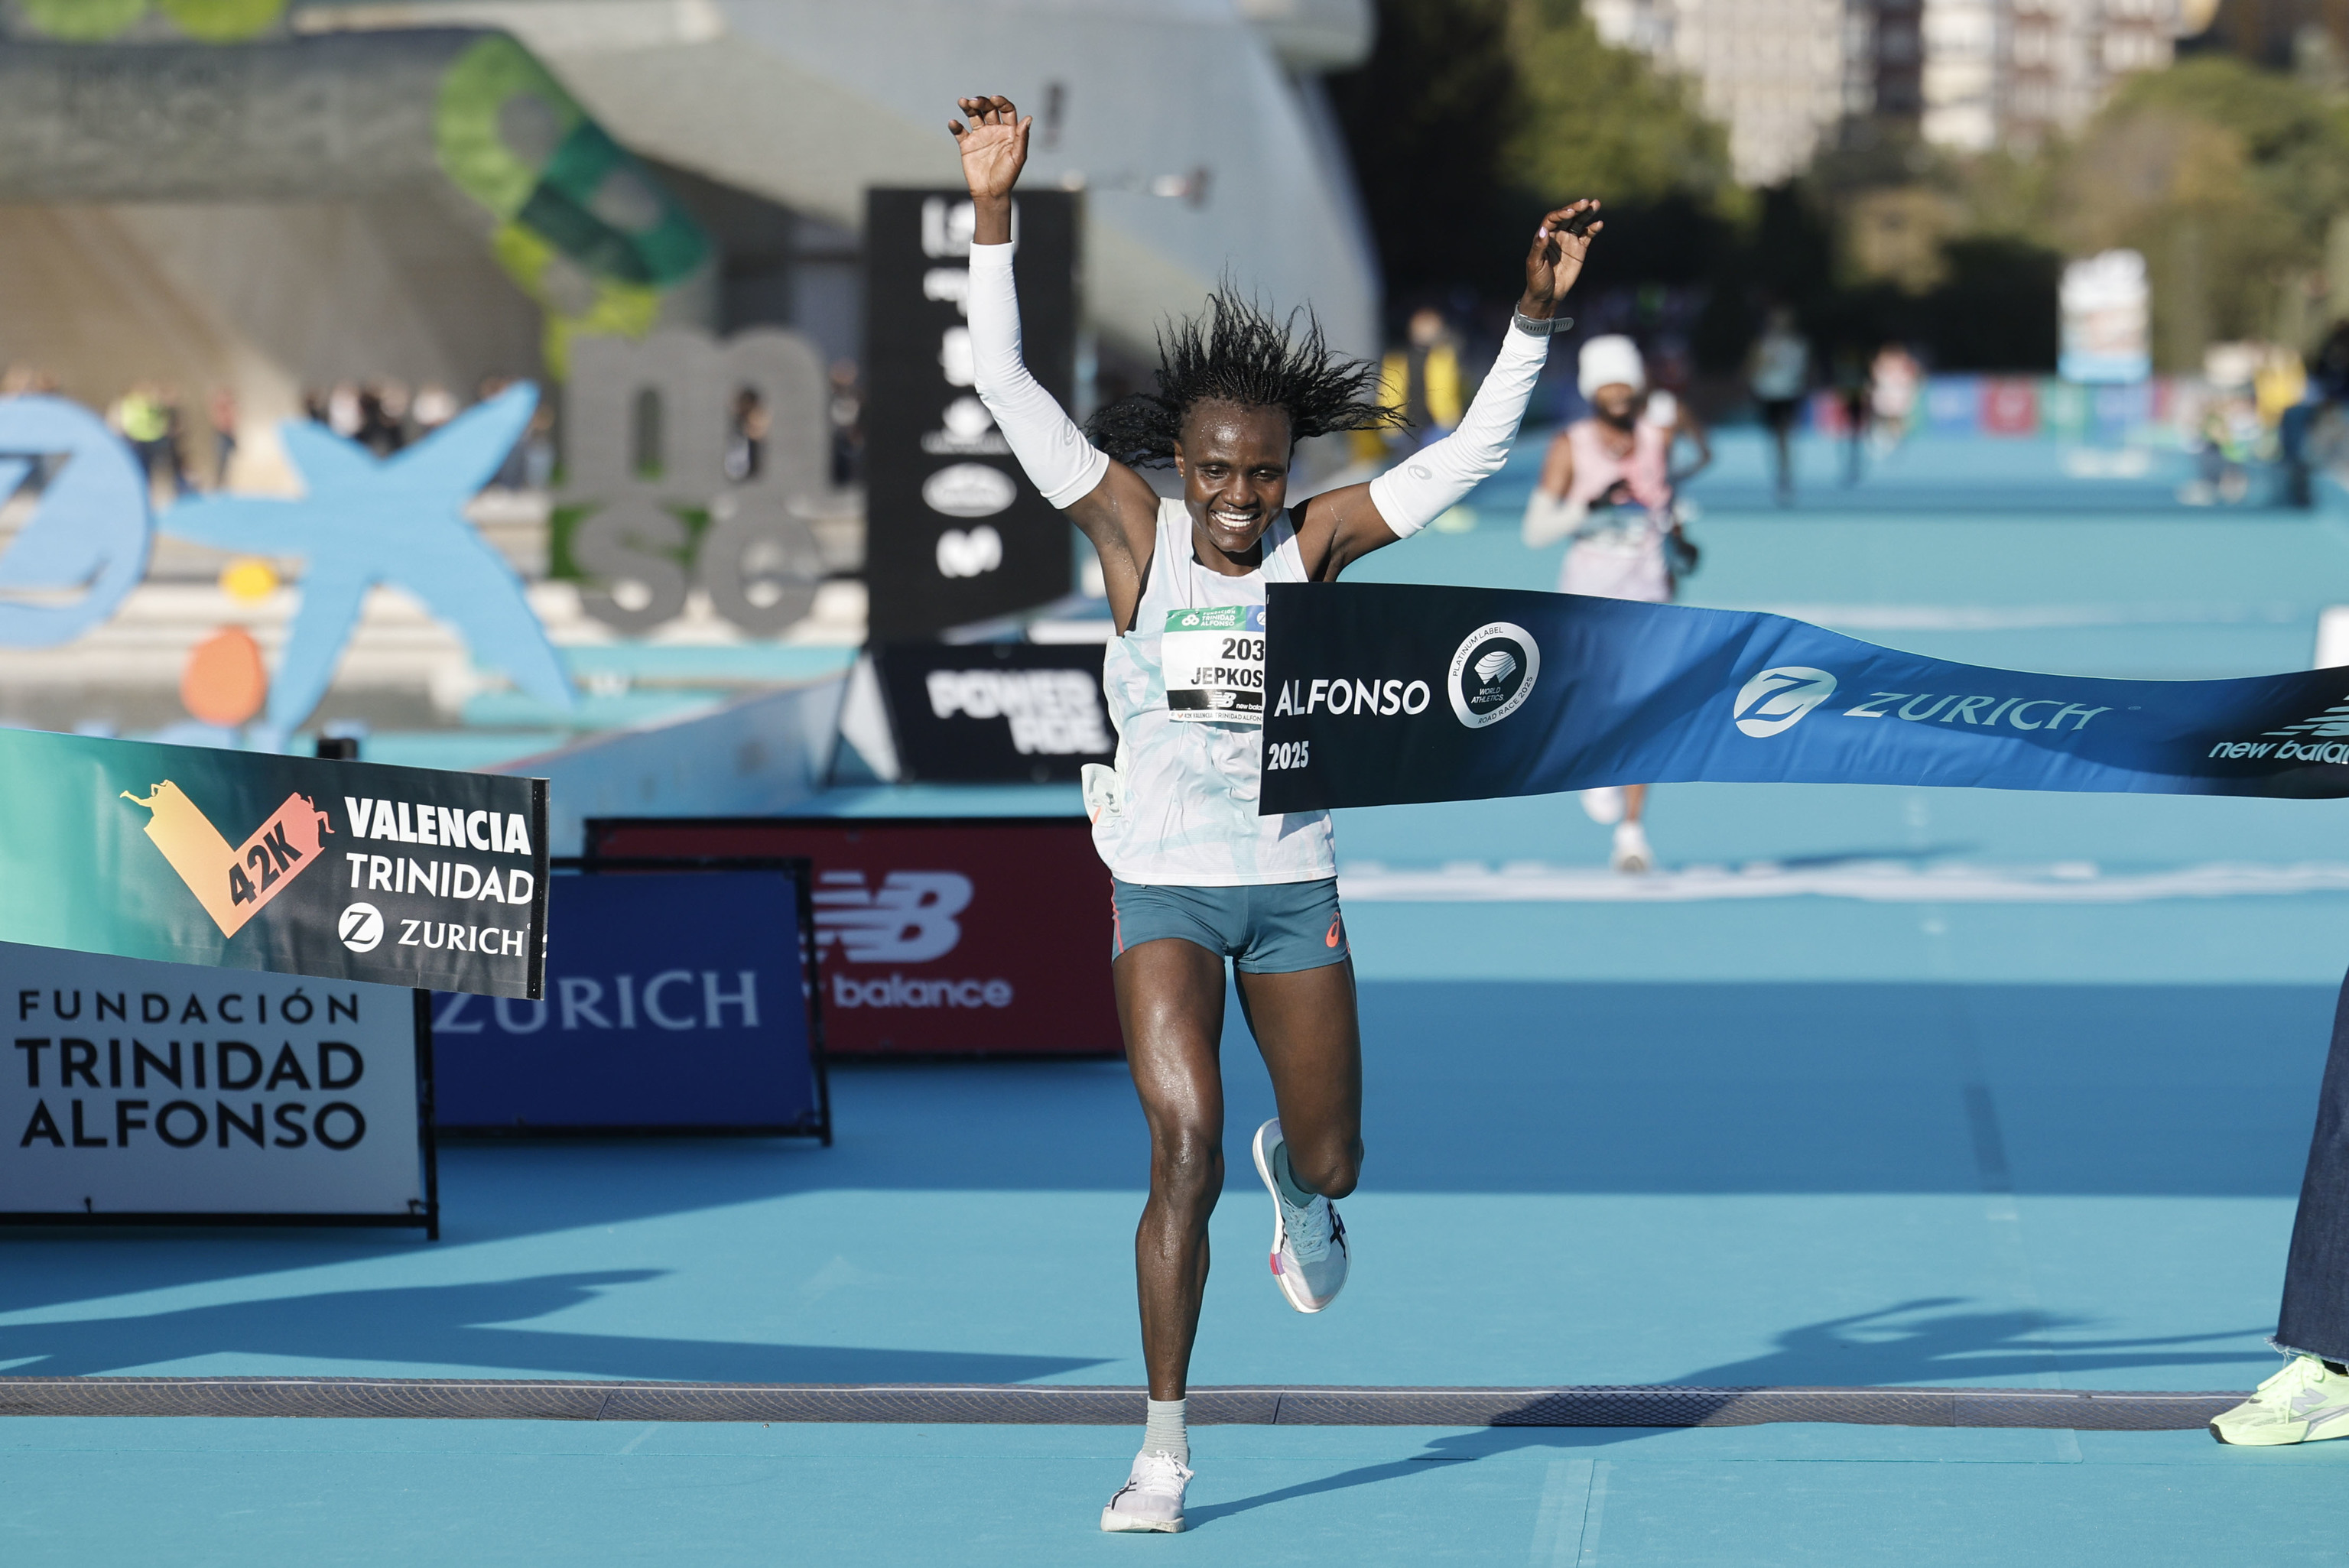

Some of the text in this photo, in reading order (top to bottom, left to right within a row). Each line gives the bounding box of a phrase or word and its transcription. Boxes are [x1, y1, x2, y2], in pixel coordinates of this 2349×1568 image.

[1221, 638, 1265, 661] 203
[1453, 626, 1503, 677] PLATINUM LABEL
[1191, 667, 1263, 688] JEPKOS
[1273, 677, 1431, 717] ALFONSO
[1479, 687, 1501, 696] WORLD
[1470, 694, 1504, 704] ATHLETICS
[1477, 676, 1533, 725] ROAD RACE 2025
[1843, 691, 2114, 731] ZURICH
[1267, 740, 1309, 771] 2025
[2208, 742, 2278, 759] new
[344, 796, 532, 855] VALENCIA
[229, 820, 304, 907] 42K
[346, 852, 534, 905] TRINIDAD
[398, 919, 525, 957] ZURICH
[18, 987, 359, 1025] FUNDACIÓN
[832, 971, 1014, 1008] balance
[14, 1037, 366, 1092] TRINIDAD
[19, 1098, 367, 1151] ALFONSO
